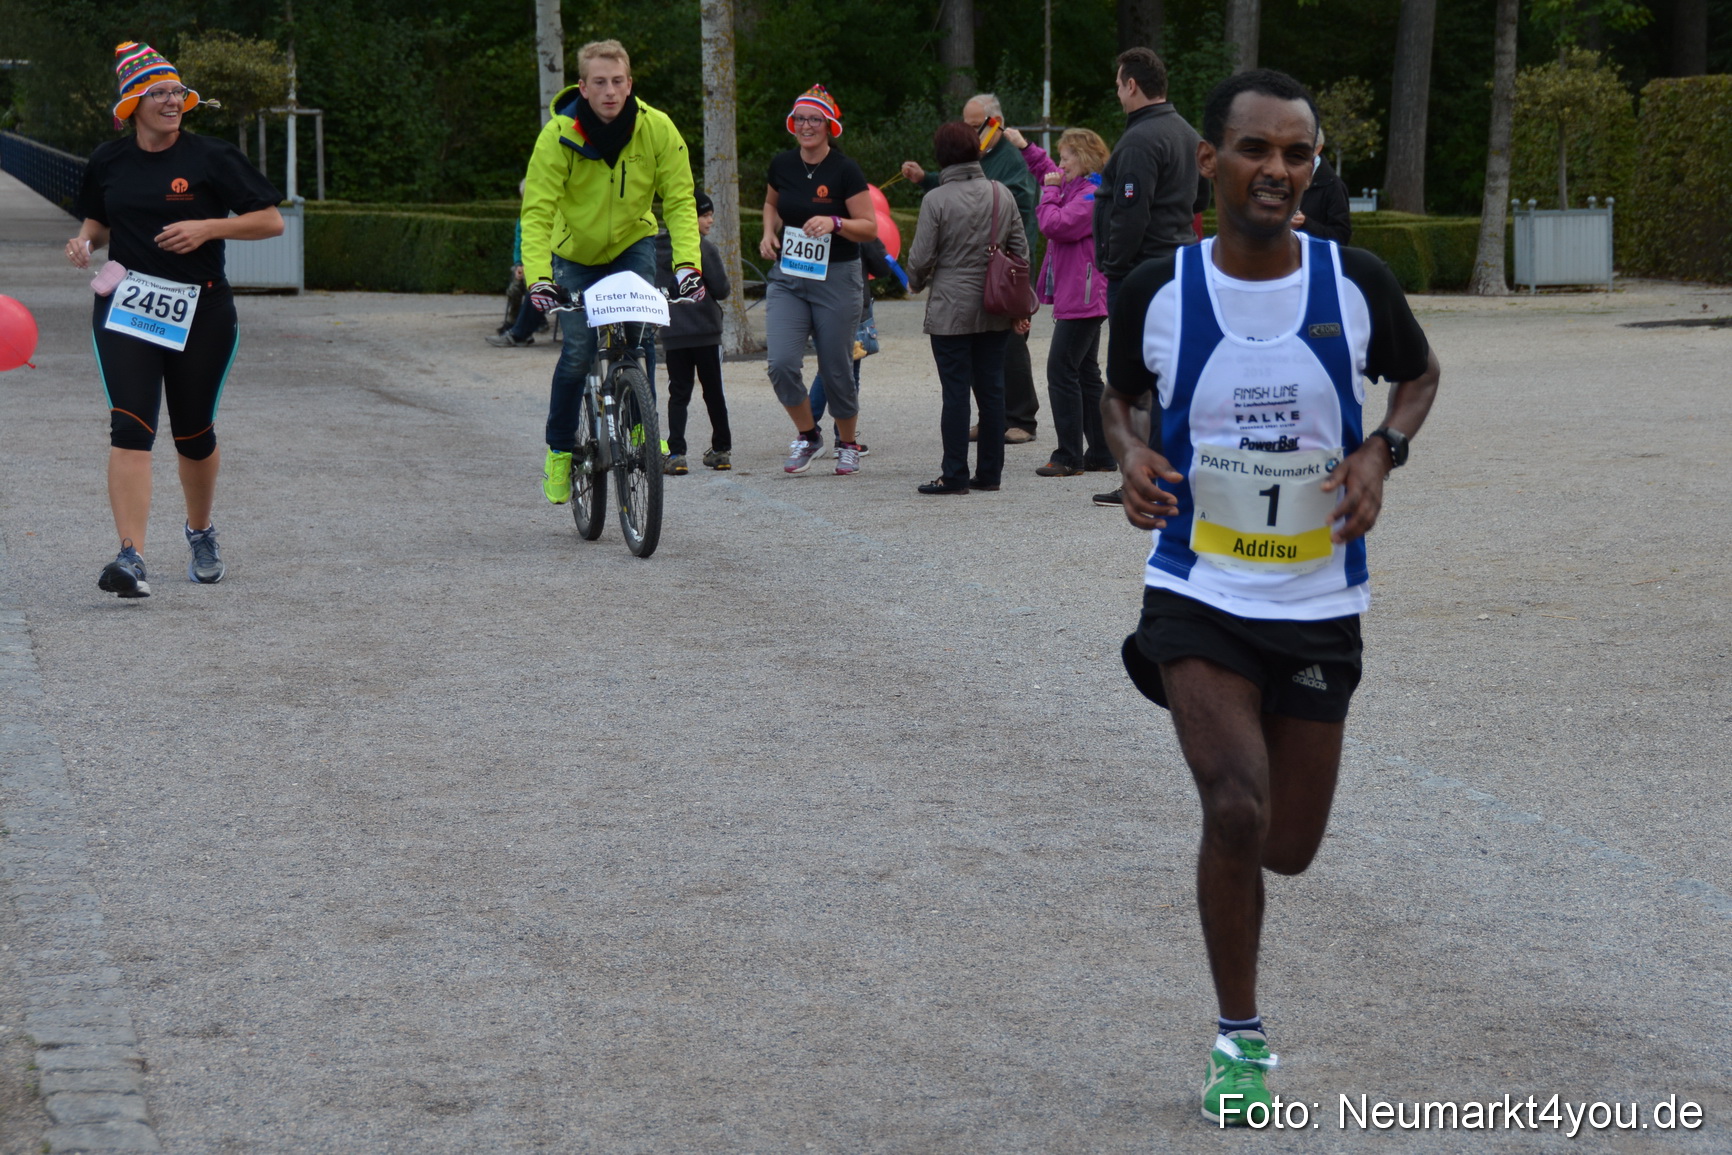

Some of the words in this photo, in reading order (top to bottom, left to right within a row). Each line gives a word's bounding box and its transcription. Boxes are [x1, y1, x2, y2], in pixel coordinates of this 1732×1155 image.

[785, 239, 825, 261] 2460
[789, 261, 815, 272] Stefanie
[150, 282, 186, 296] Neumarkt
[595, 293, 627, 302] Erster
[630, 292, 657, 301] Mann
[122, 285, 189, 323] 2459
[592, 306, 664, 316] Halbmarathon
[130, 316, 166, 335] Sandra
[1234, 386, 1270, 400] FINISH
[1273, 384, 1299, 398] LINE
[1235, 410, 1300, 424] FALKE
[1239, 435, 1300, 451] PowerBar
[1200, 455, 1250, 475] PARTL
[1253, 463, 1320, 477] Neumarkt
[1259, 484, 1281, 527] 1
[1233, 538, 1297, 559] Addisu
[1292, 674, 1328, 691] adidas
